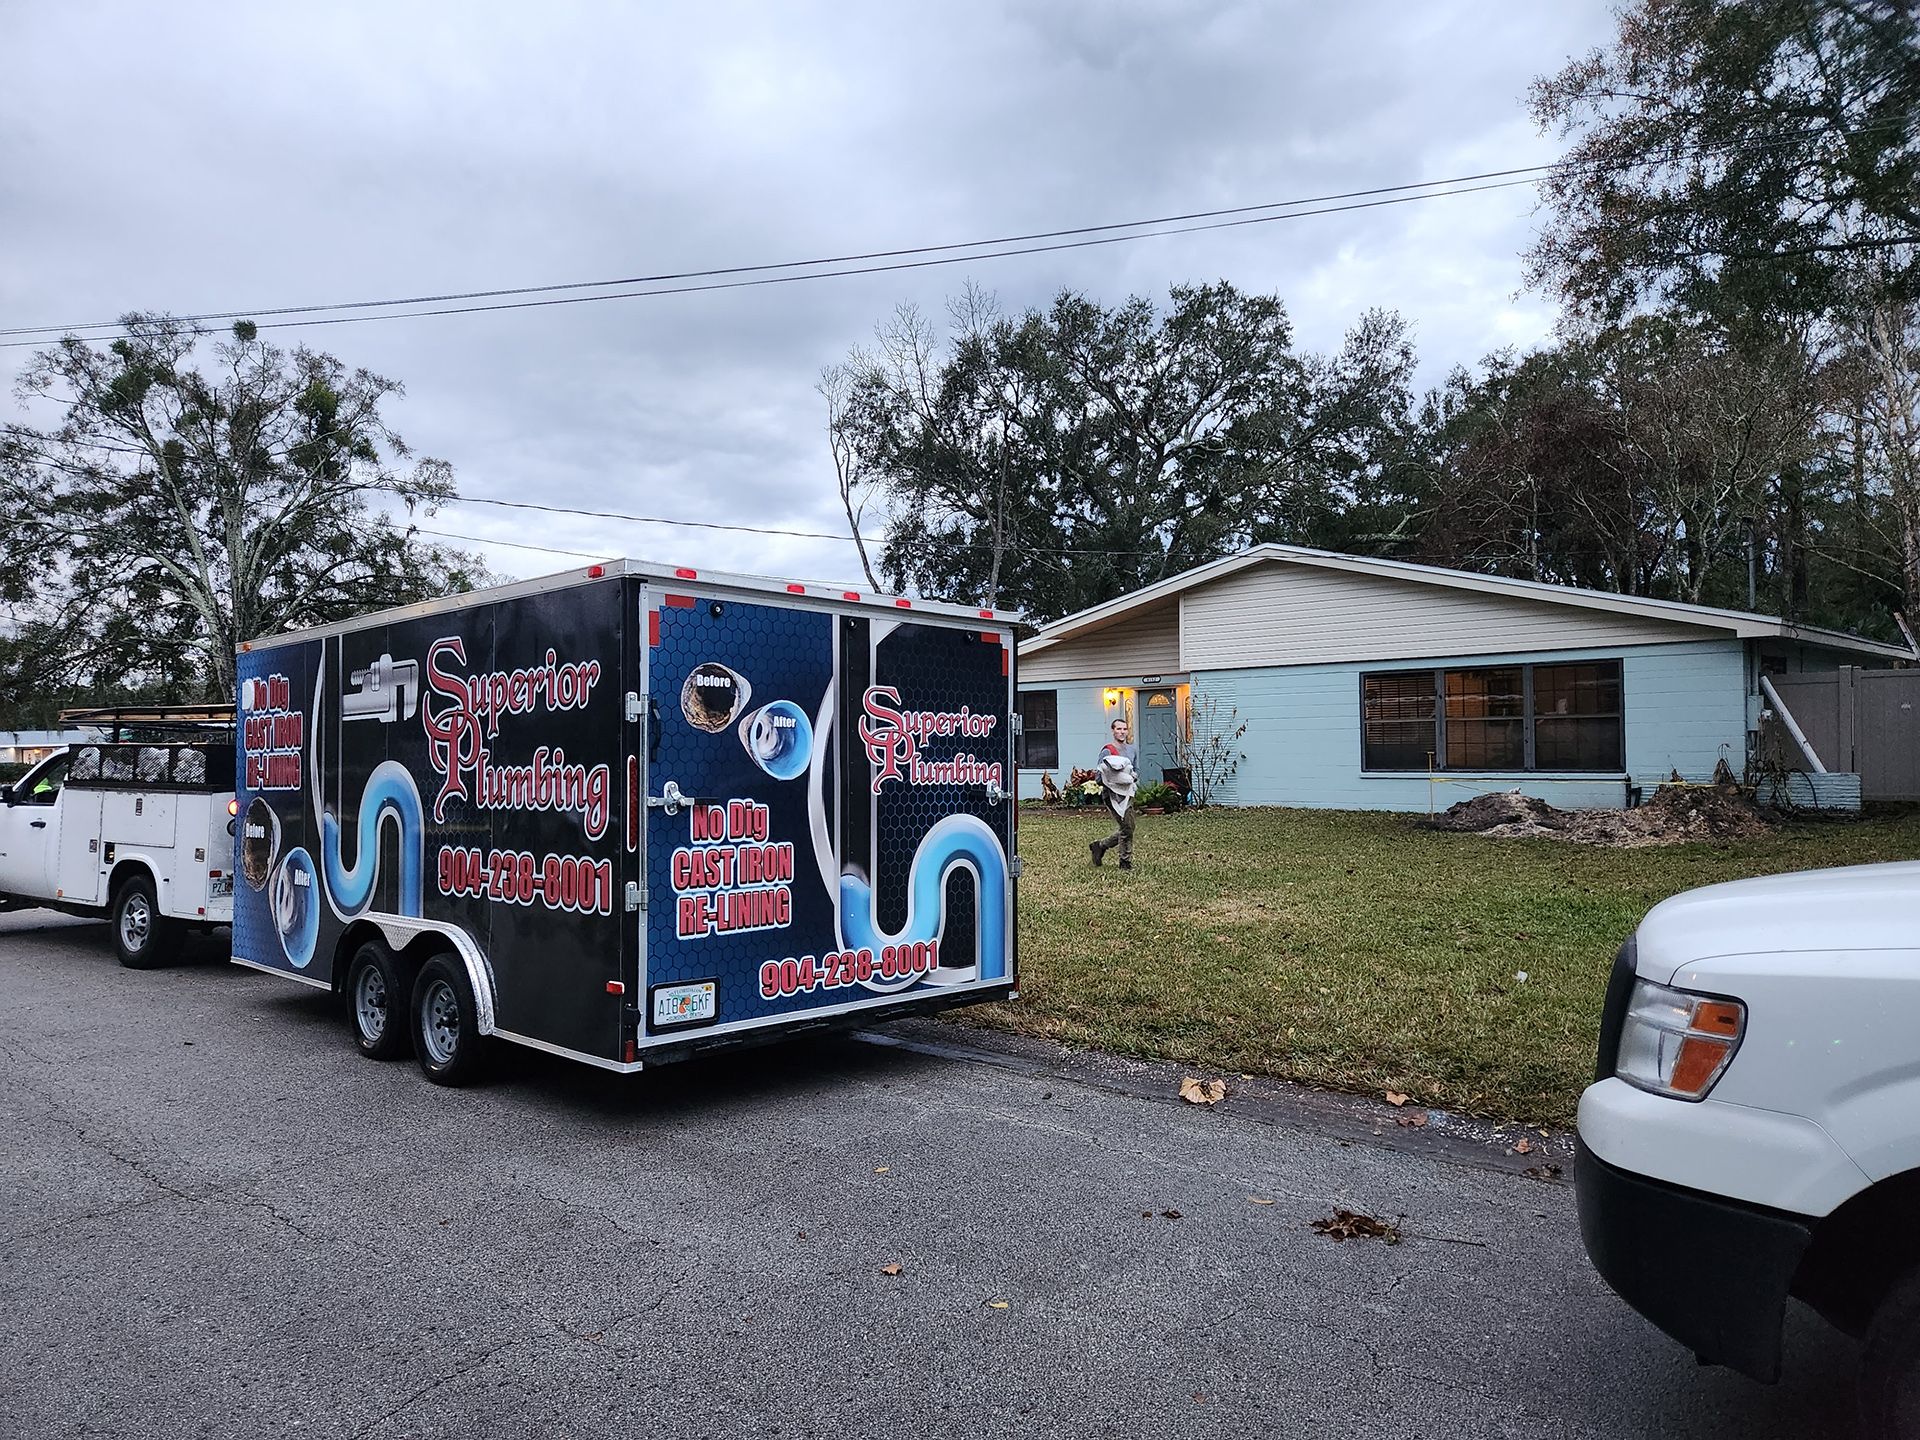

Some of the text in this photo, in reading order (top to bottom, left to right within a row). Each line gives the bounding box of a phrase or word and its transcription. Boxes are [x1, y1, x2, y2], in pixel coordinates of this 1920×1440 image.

[252, 673, 289, 713] No Dig
[424, 636, 600, 740] Superior
[696, 674, 731, 688] Before
[244, 711, 302, 753] CAST IRON
[773, 715, 797, 728] After
[858, 685, 997, 748] Superior
[246, 753, 301, 789] RE-LINING
[429, 707, 610, 840] Plumbing
[865, 728, 1002, 795] Plumbing
[245, 822, 265, 839] Before
[691, 799, 768, 843] No Dig
[294, 868, 311, 887] After
[438, 846, 611, 916] 904-238-8001
[672, 843, 793, 891] CAST IRON
[677, 887, 791, 938] RE-LINING
[760, 939, 939, 999] 904-238-8001
